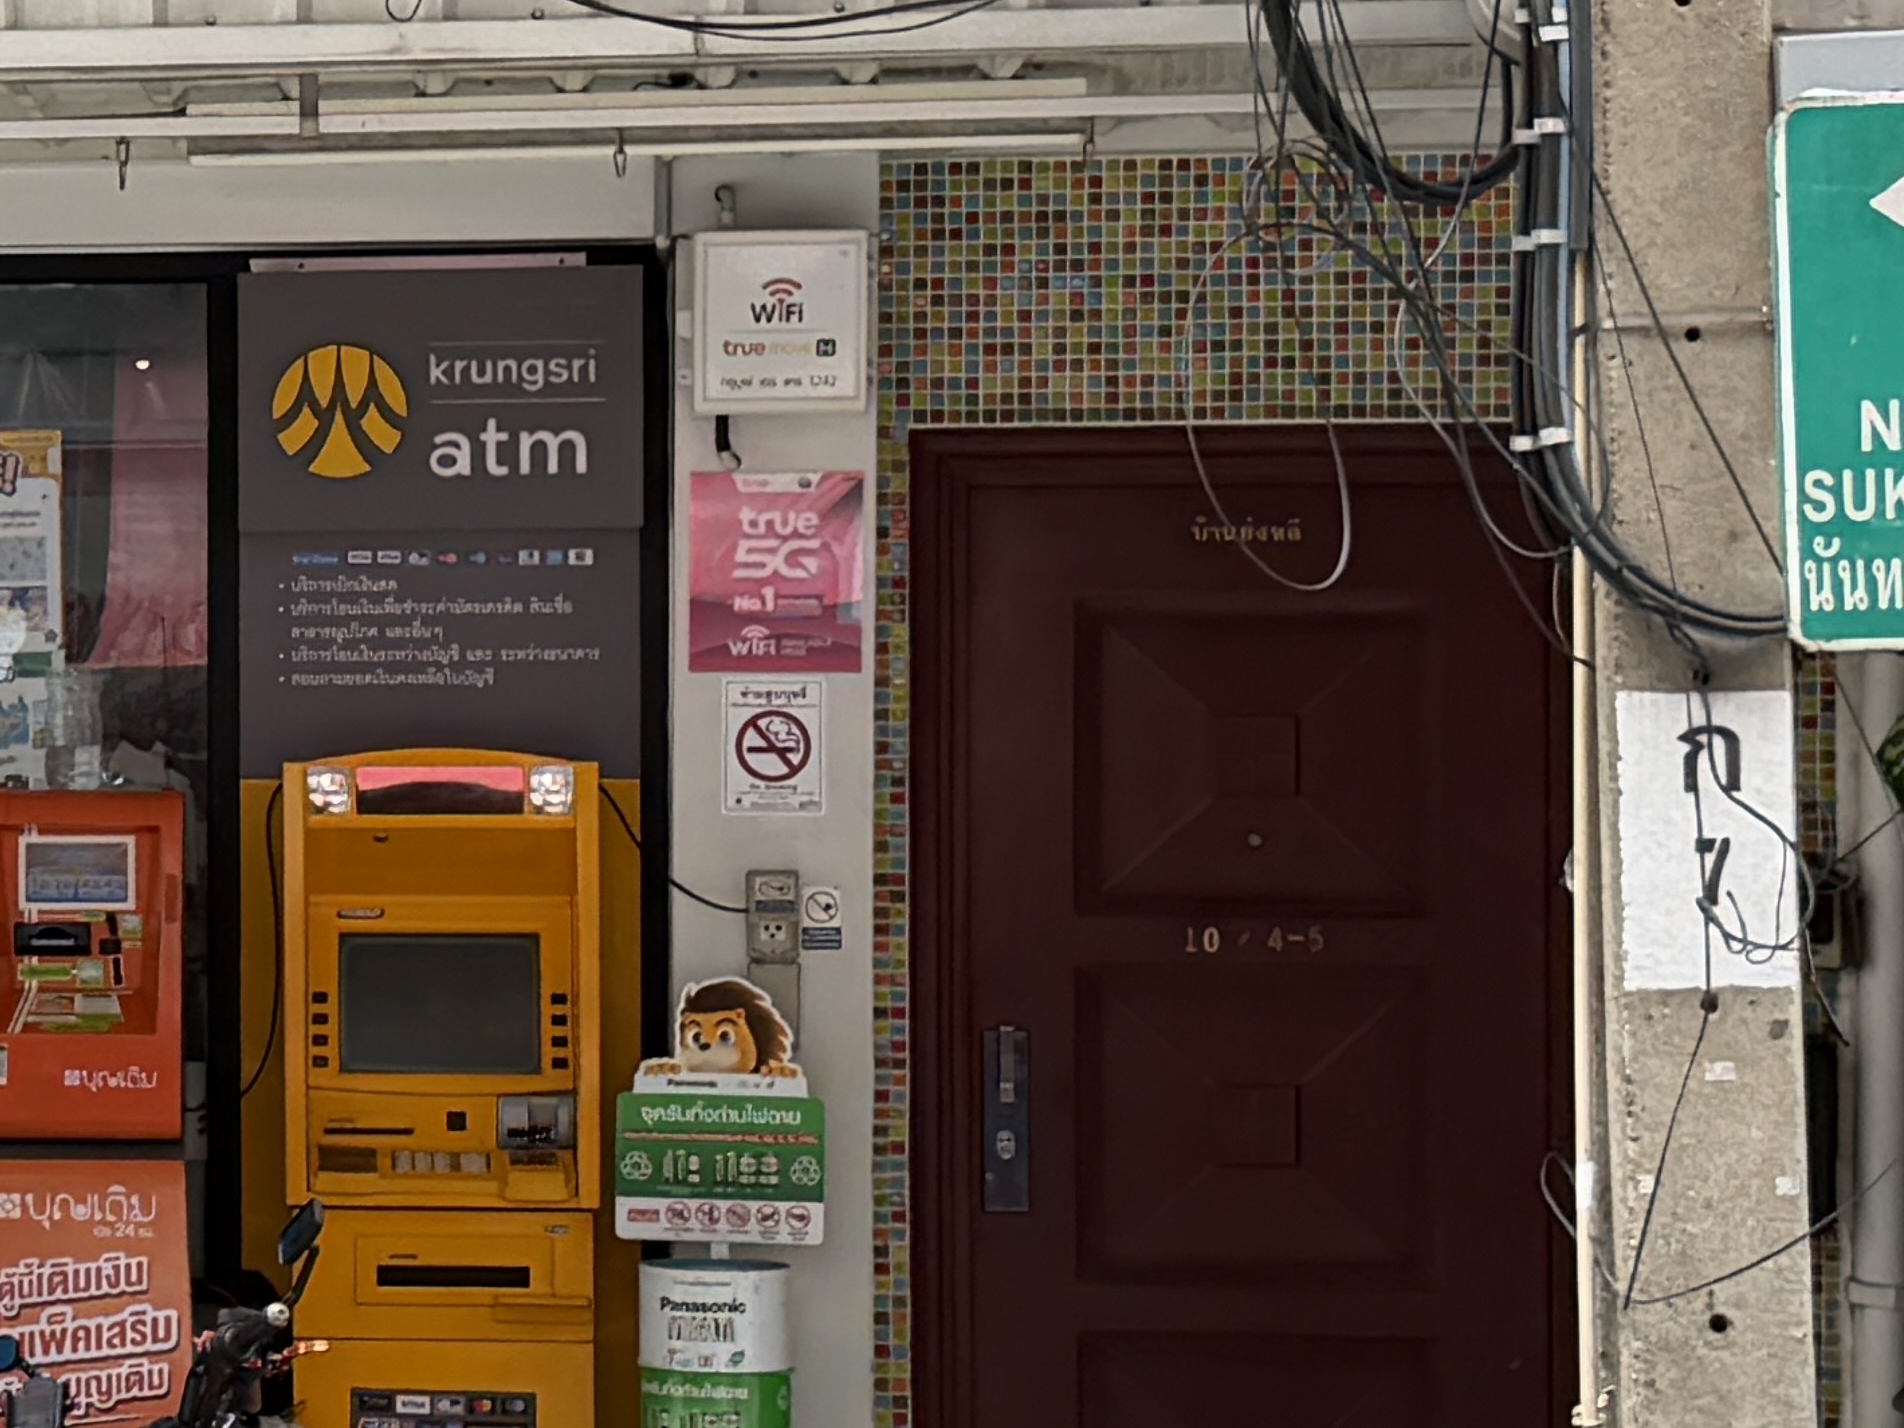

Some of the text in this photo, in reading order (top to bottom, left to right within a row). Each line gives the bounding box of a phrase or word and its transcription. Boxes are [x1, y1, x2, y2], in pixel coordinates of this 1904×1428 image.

[429, 349, 597, 392] krungsri
[429, 417, 589, 477] atm
[738, 505, 820, 536] true
[732, 538, 822, 579] 5G
[659, 1295, 747, 1314] Panasonic
